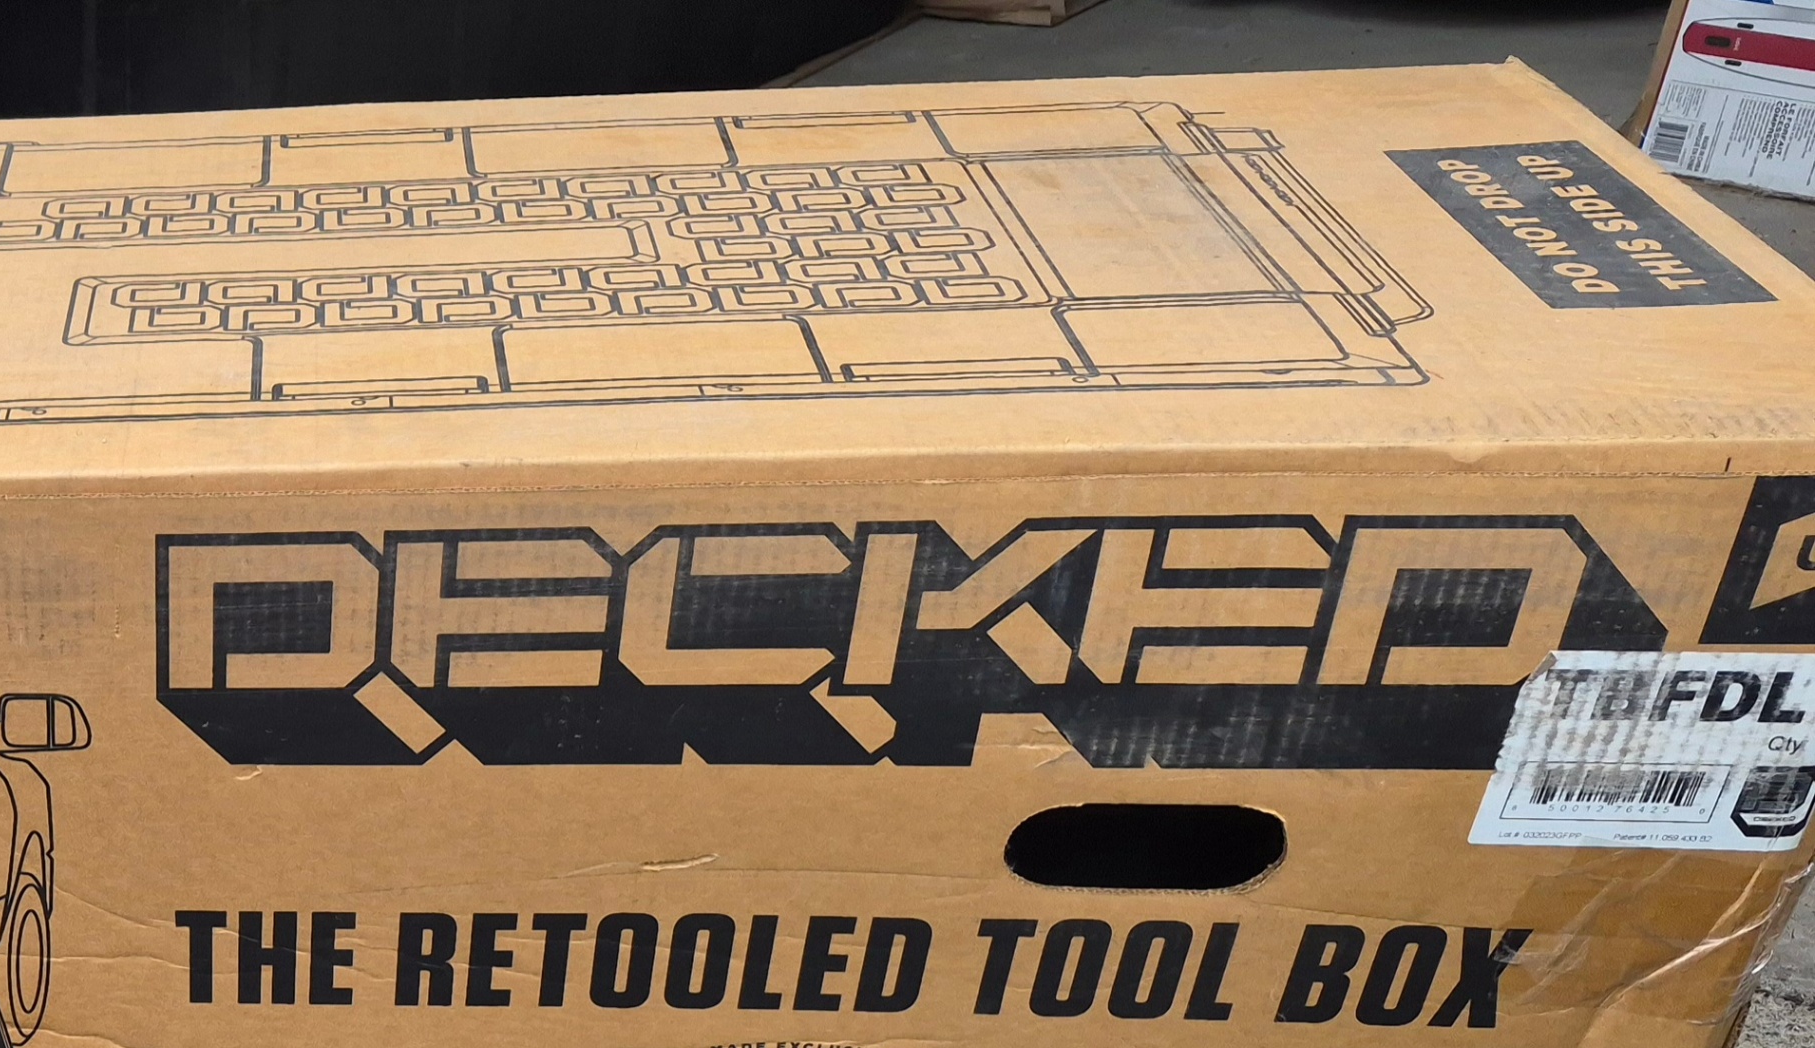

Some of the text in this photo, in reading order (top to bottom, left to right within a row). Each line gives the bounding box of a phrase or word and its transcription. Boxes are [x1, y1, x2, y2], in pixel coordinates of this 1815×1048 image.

[1762, 100, 1783, 153] COMPREND
[1437, 159, 1620, 292] DO NOT DROP
[1517, 155, 1708, 290] THIS SIDE UP
[155, 515, 1655, 768] DECKED
[1768, 735, 1804, 755] Qty
[174, 910, 1534, 1029] THE RETOOLED TOOL BOX
